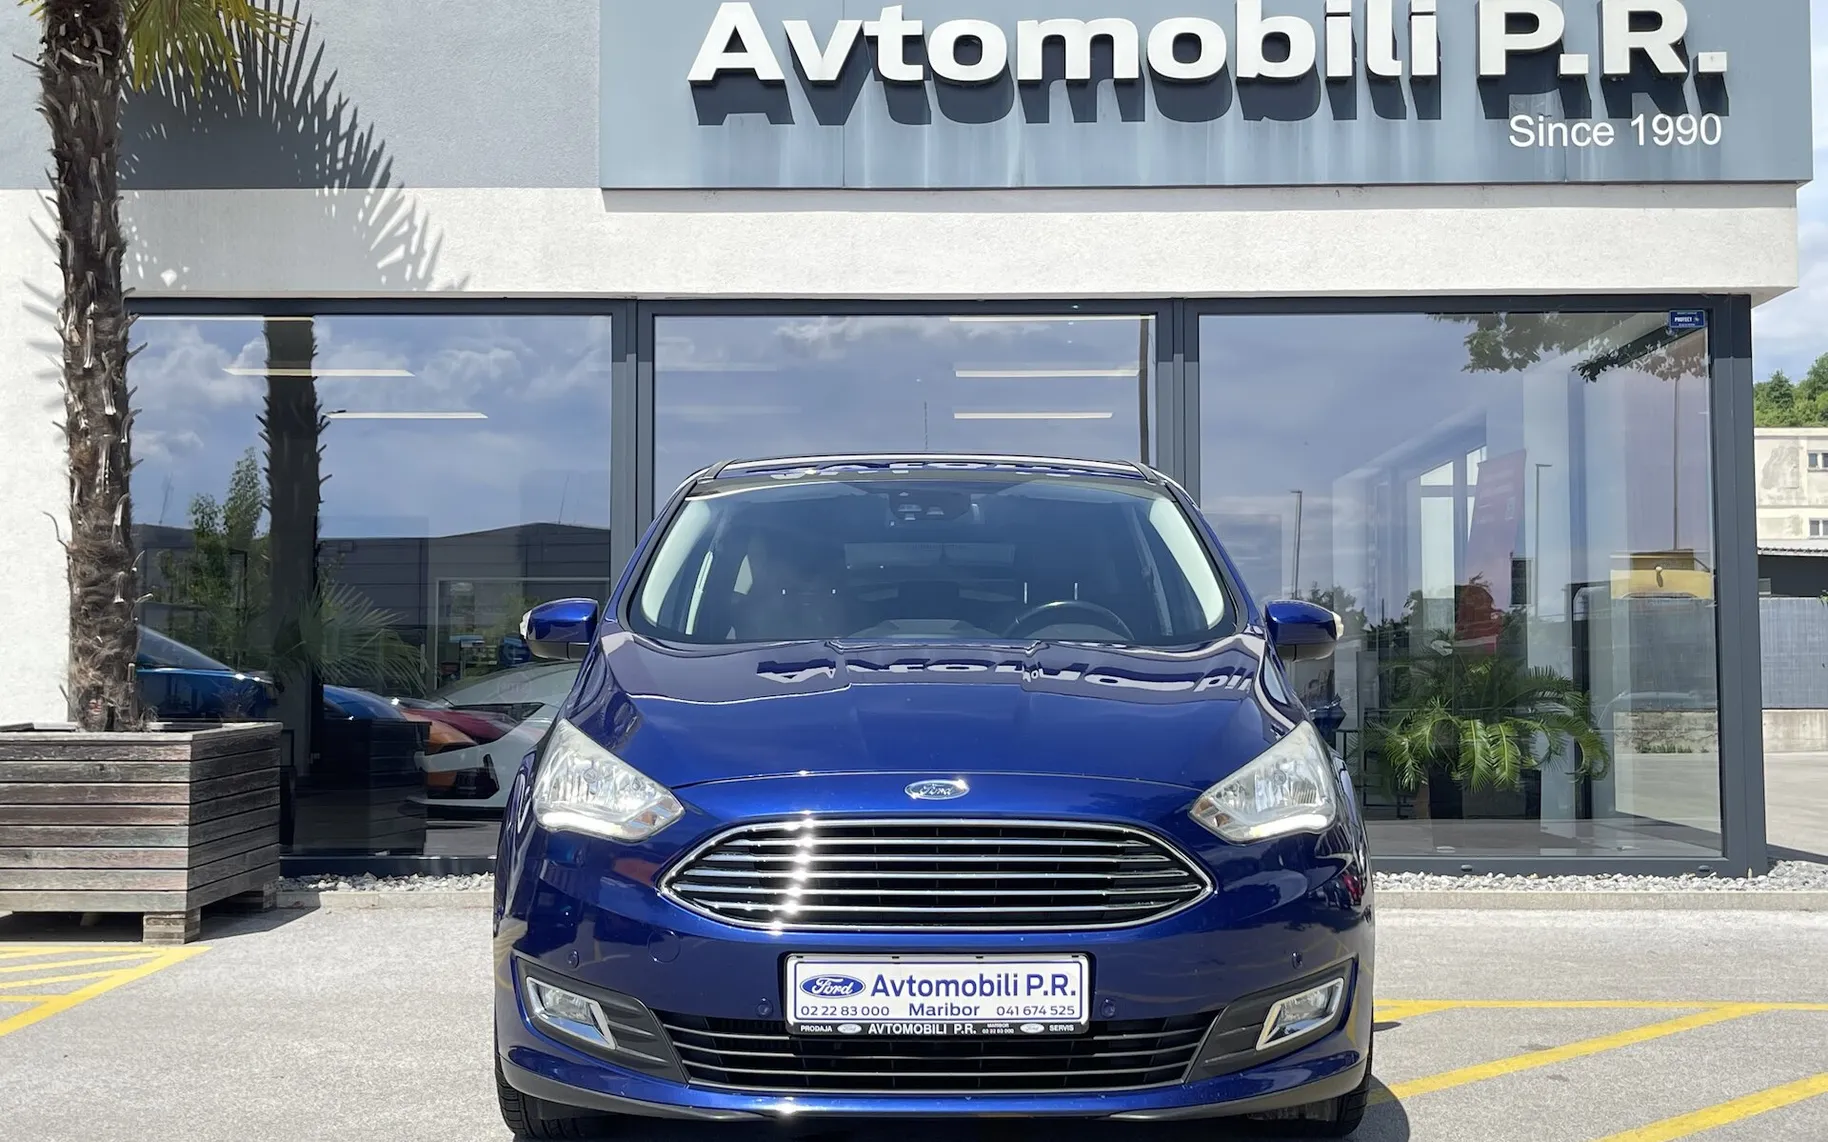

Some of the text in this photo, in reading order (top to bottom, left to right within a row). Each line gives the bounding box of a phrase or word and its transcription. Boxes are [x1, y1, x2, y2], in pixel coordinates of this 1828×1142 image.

[688, 0, 1728, 83] Avtomobili P.R.
[1509, 113, 1722, 148] Since 1990
[870, 973, 1076, 997] Avtomobili P.R.
[800, 1005, 890, 1016] 02 22 83 000
[908, 1002, 980, 1016] Maribor
[996, 1005, 1075, 1016] 041 674 525
[800, 1024, 833, 1033] PRODAJA
[868, 1023, 977, 1035] AVTOMOBILI P.R.
[1049, 1024, 1075, 1032] SERVIS
